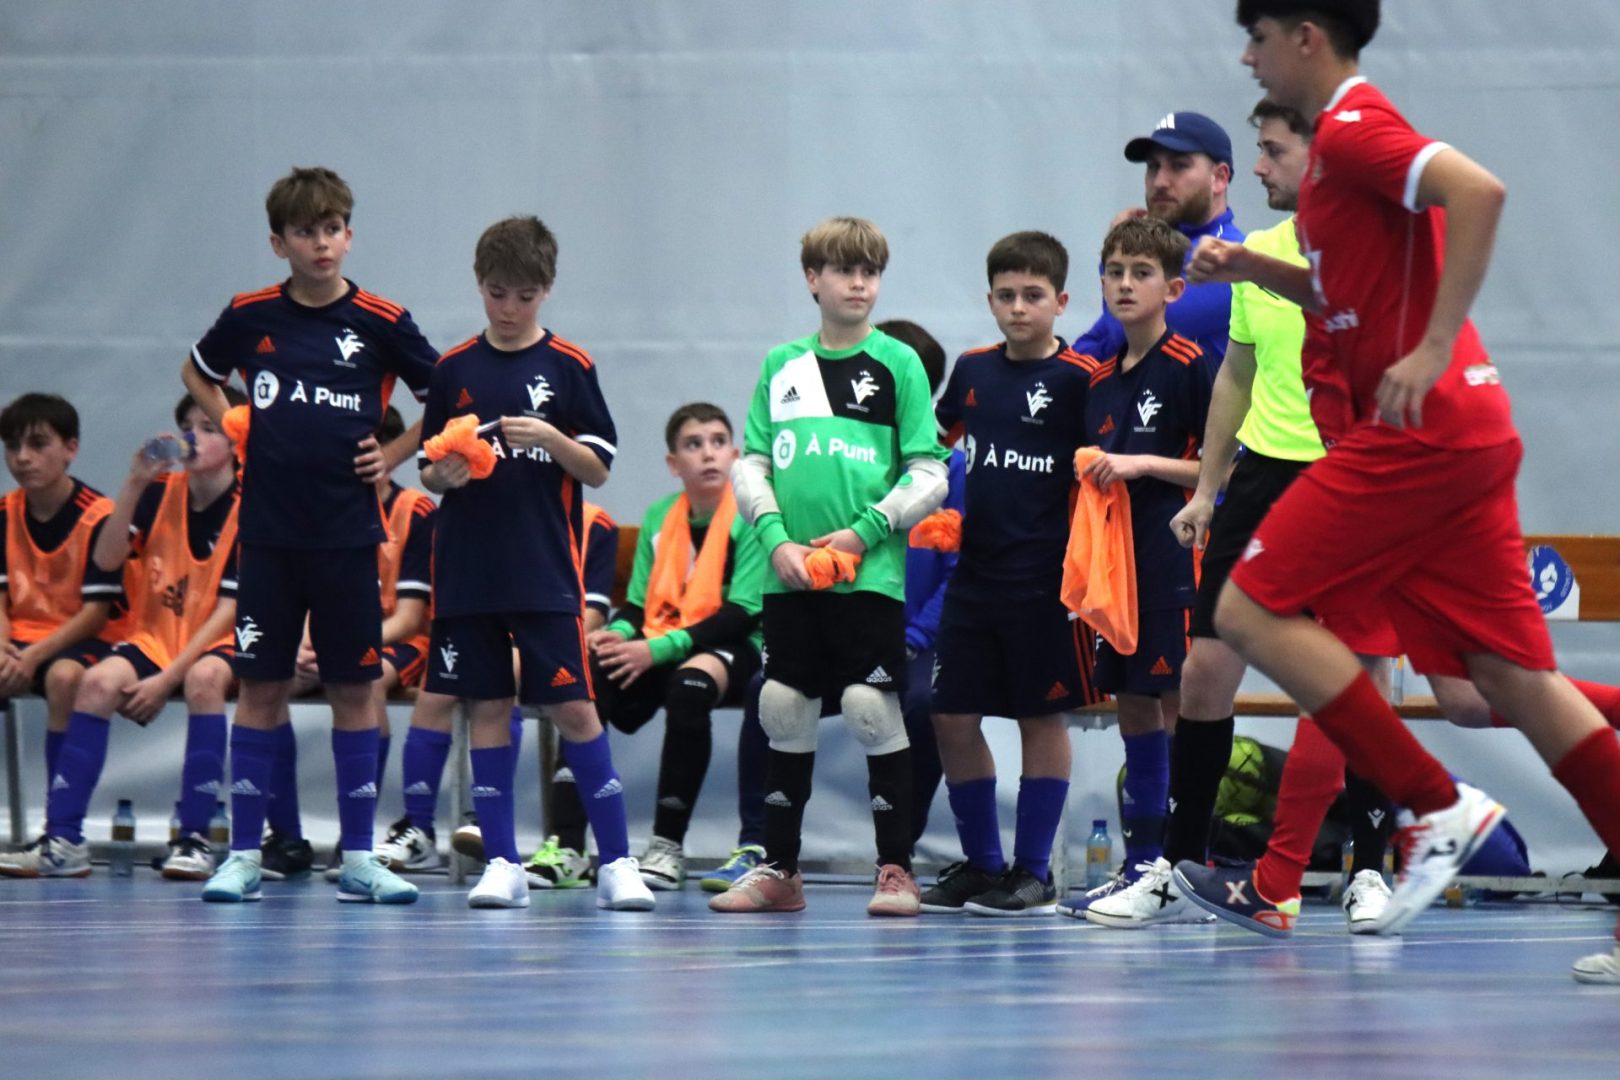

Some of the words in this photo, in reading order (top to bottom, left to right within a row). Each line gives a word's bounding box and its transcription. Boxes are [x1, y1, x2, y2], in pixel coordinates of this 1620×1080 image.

[290, 380, 307, 403] À
[315, 386, 361, 412] Punt
[805, 432, 821, 456] À
[828, 437, 877, 464] Punt
[984, 443, 998, 467] À
[1004, 449, 1054, 473] Punt
